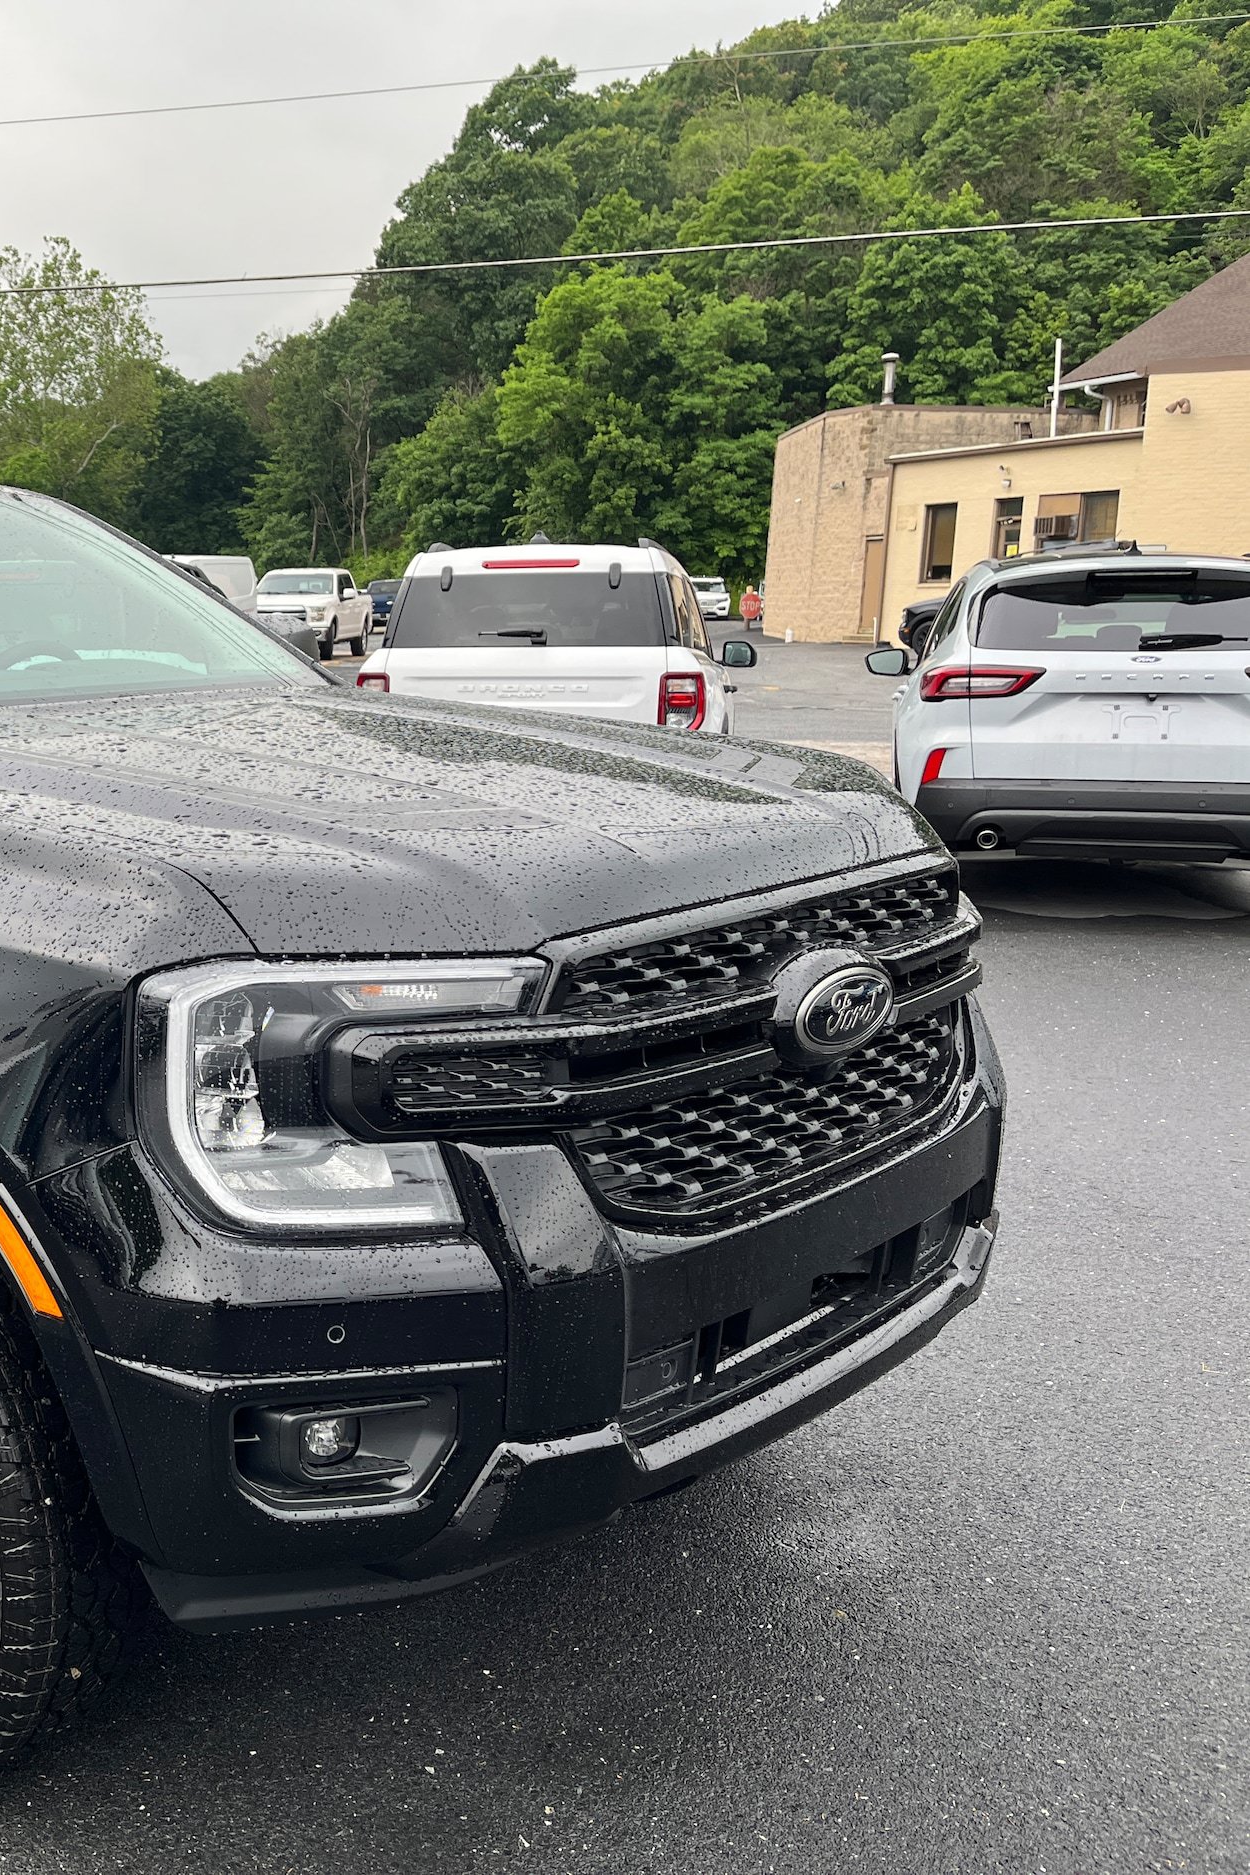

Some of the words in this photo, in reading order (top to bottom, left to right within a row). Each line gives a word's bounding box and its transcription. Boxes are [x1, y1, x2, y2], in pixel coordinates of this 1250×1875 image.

[741, 600, 760, 611] STOP
[1075, 673, 1215, 681] ESCAPE
[456, 683, 589, 693] BRONCO
[826, 984, 885, 1037] Ford
